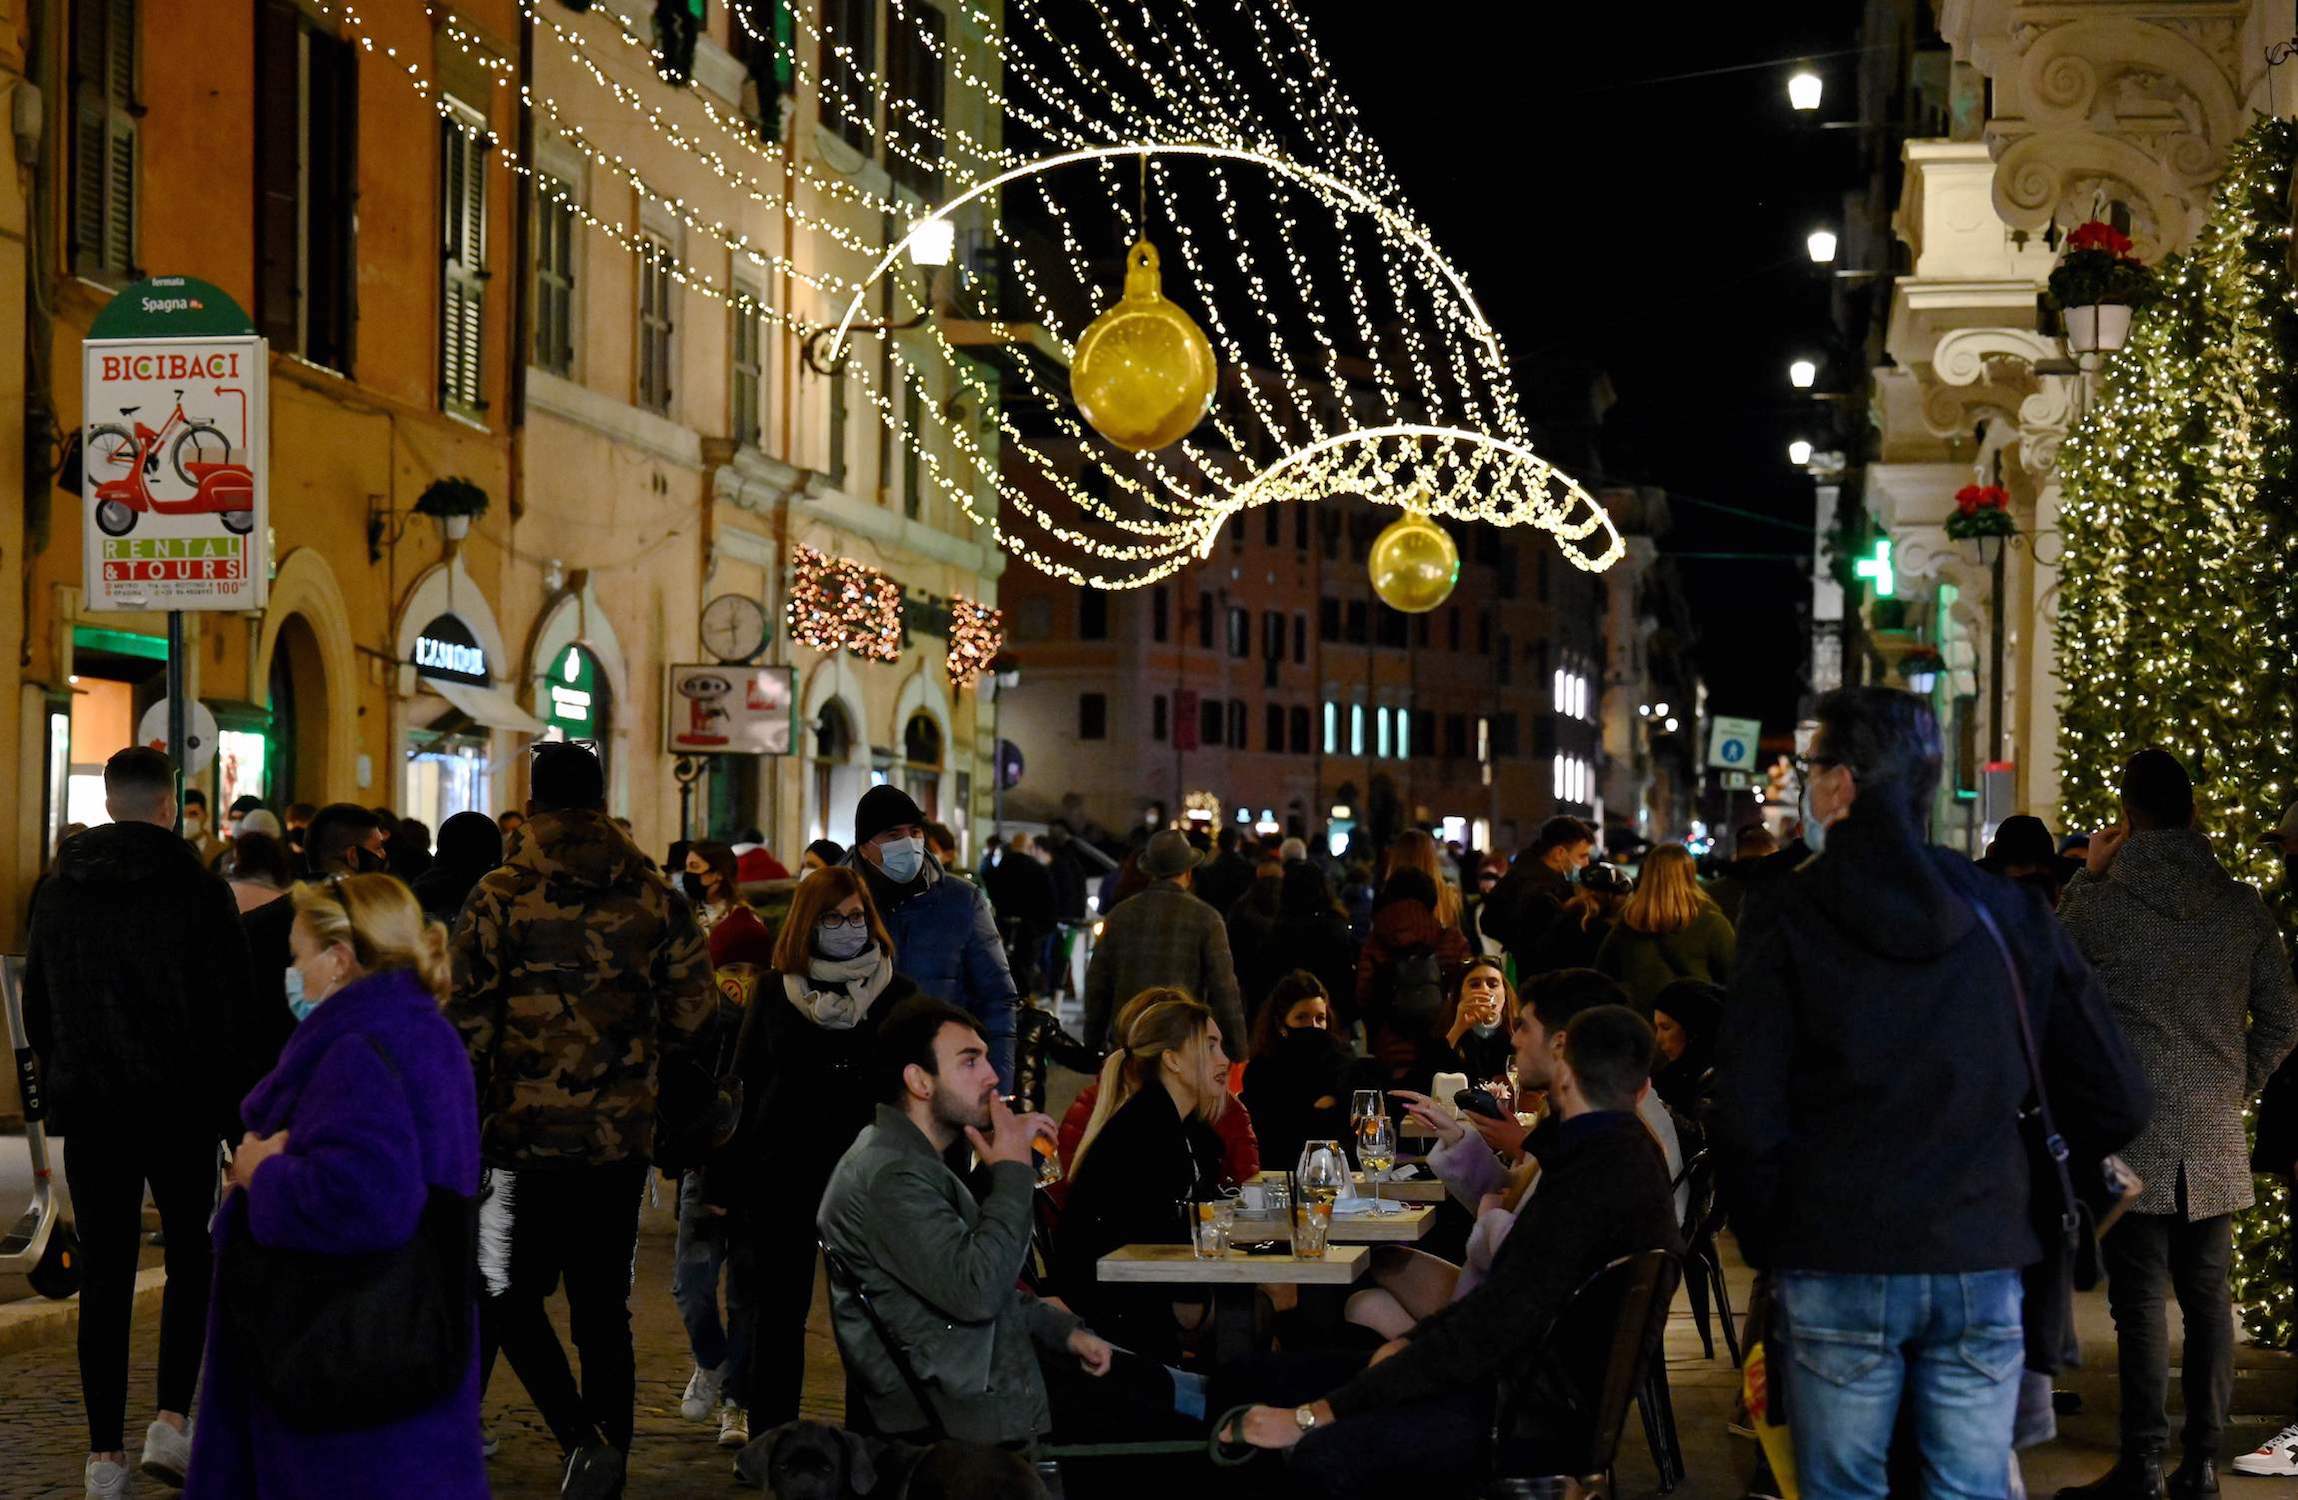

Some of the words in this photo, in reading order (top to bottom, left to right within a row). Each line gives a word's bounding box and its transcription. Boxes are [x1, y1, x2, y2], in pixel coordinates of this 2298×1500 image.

[151, 278, 185, 287] fermata
[142, 297, 188, 313] Spagna
[102, 353, 240, 381] BICIBACI
[104, 540, 239, 559] RENTAL
[216, 582, 240, 595] 100
[23, 1061, 39, 1109] BIRD
